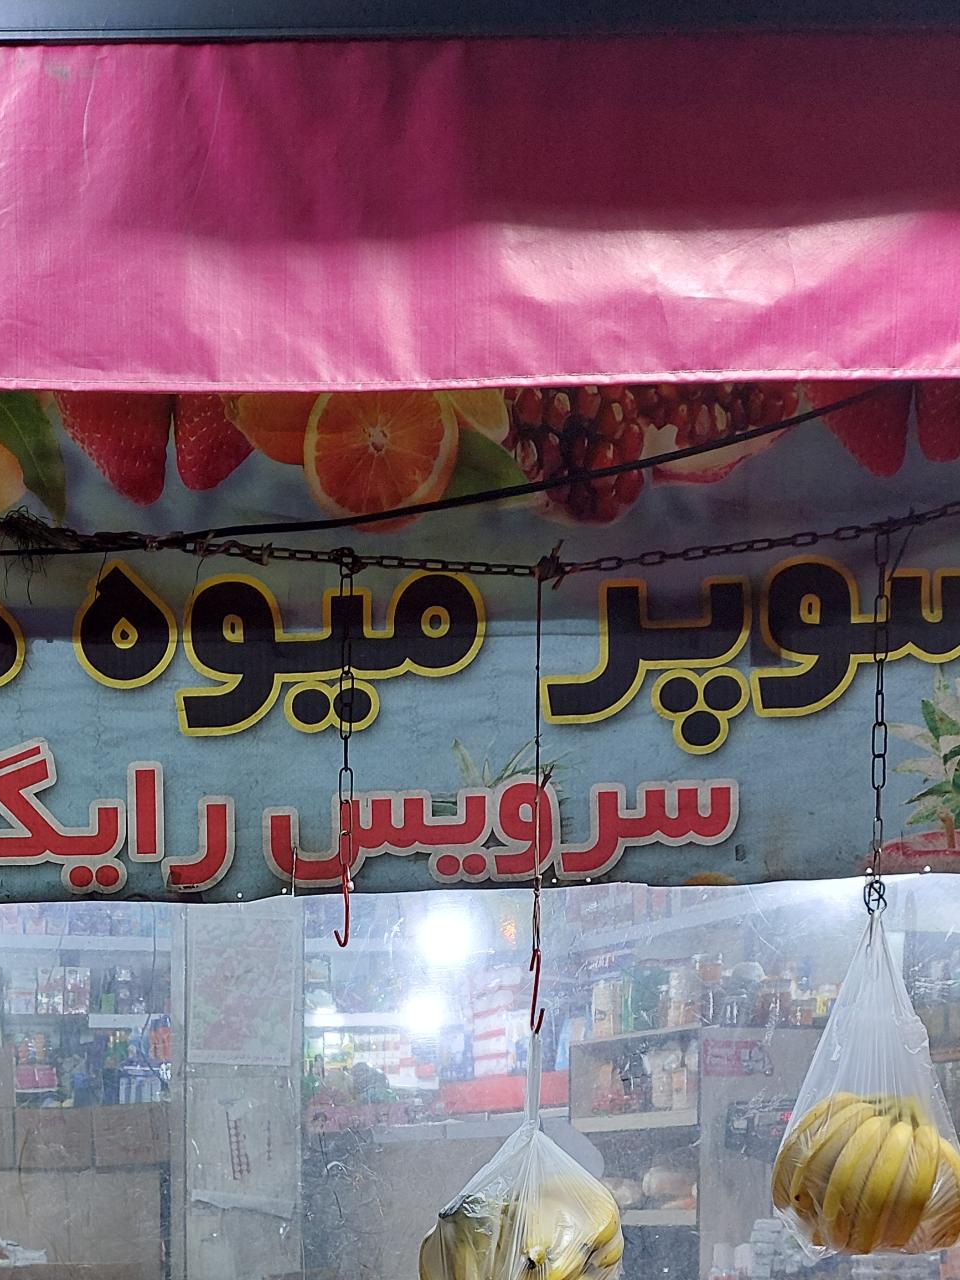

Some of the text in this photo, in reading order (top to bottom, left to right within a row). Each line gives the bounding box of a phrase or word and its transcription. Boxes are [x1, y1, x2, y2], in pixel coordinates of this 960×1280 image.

[73, 559, 487, 738] میوه
[542, 554, 960, 756] سوپر
[262, 770, 740, 891] سرویس
